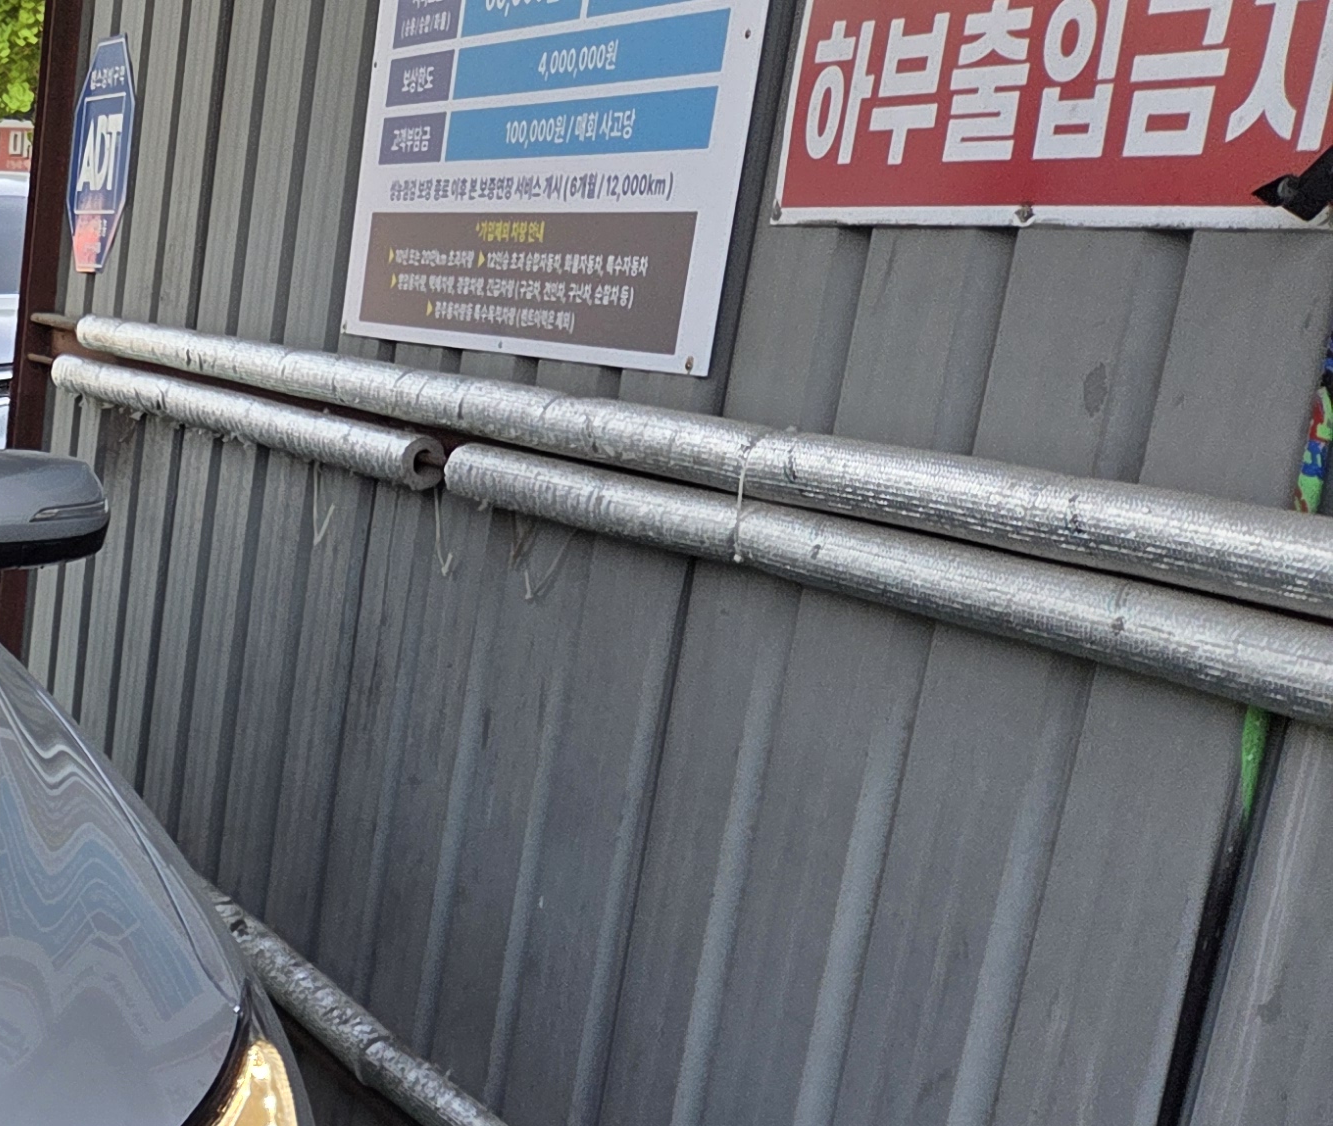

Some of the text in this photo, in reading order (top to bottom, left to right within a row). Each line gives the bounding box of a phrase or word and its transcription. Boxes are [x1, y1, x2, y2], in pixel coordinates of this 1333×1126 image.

[537, 40, 619, 81] 4,000,000원
[401, 66, 435, 93] 보상한도
[390, 125, 432, 152] 고객부담금
[599, 108, 636, 141] 사고당
[77, 113, 123, 192] ADT
[478, 176, 514, 201] 보증연장
[514, 175, 542, 201] 서비스
